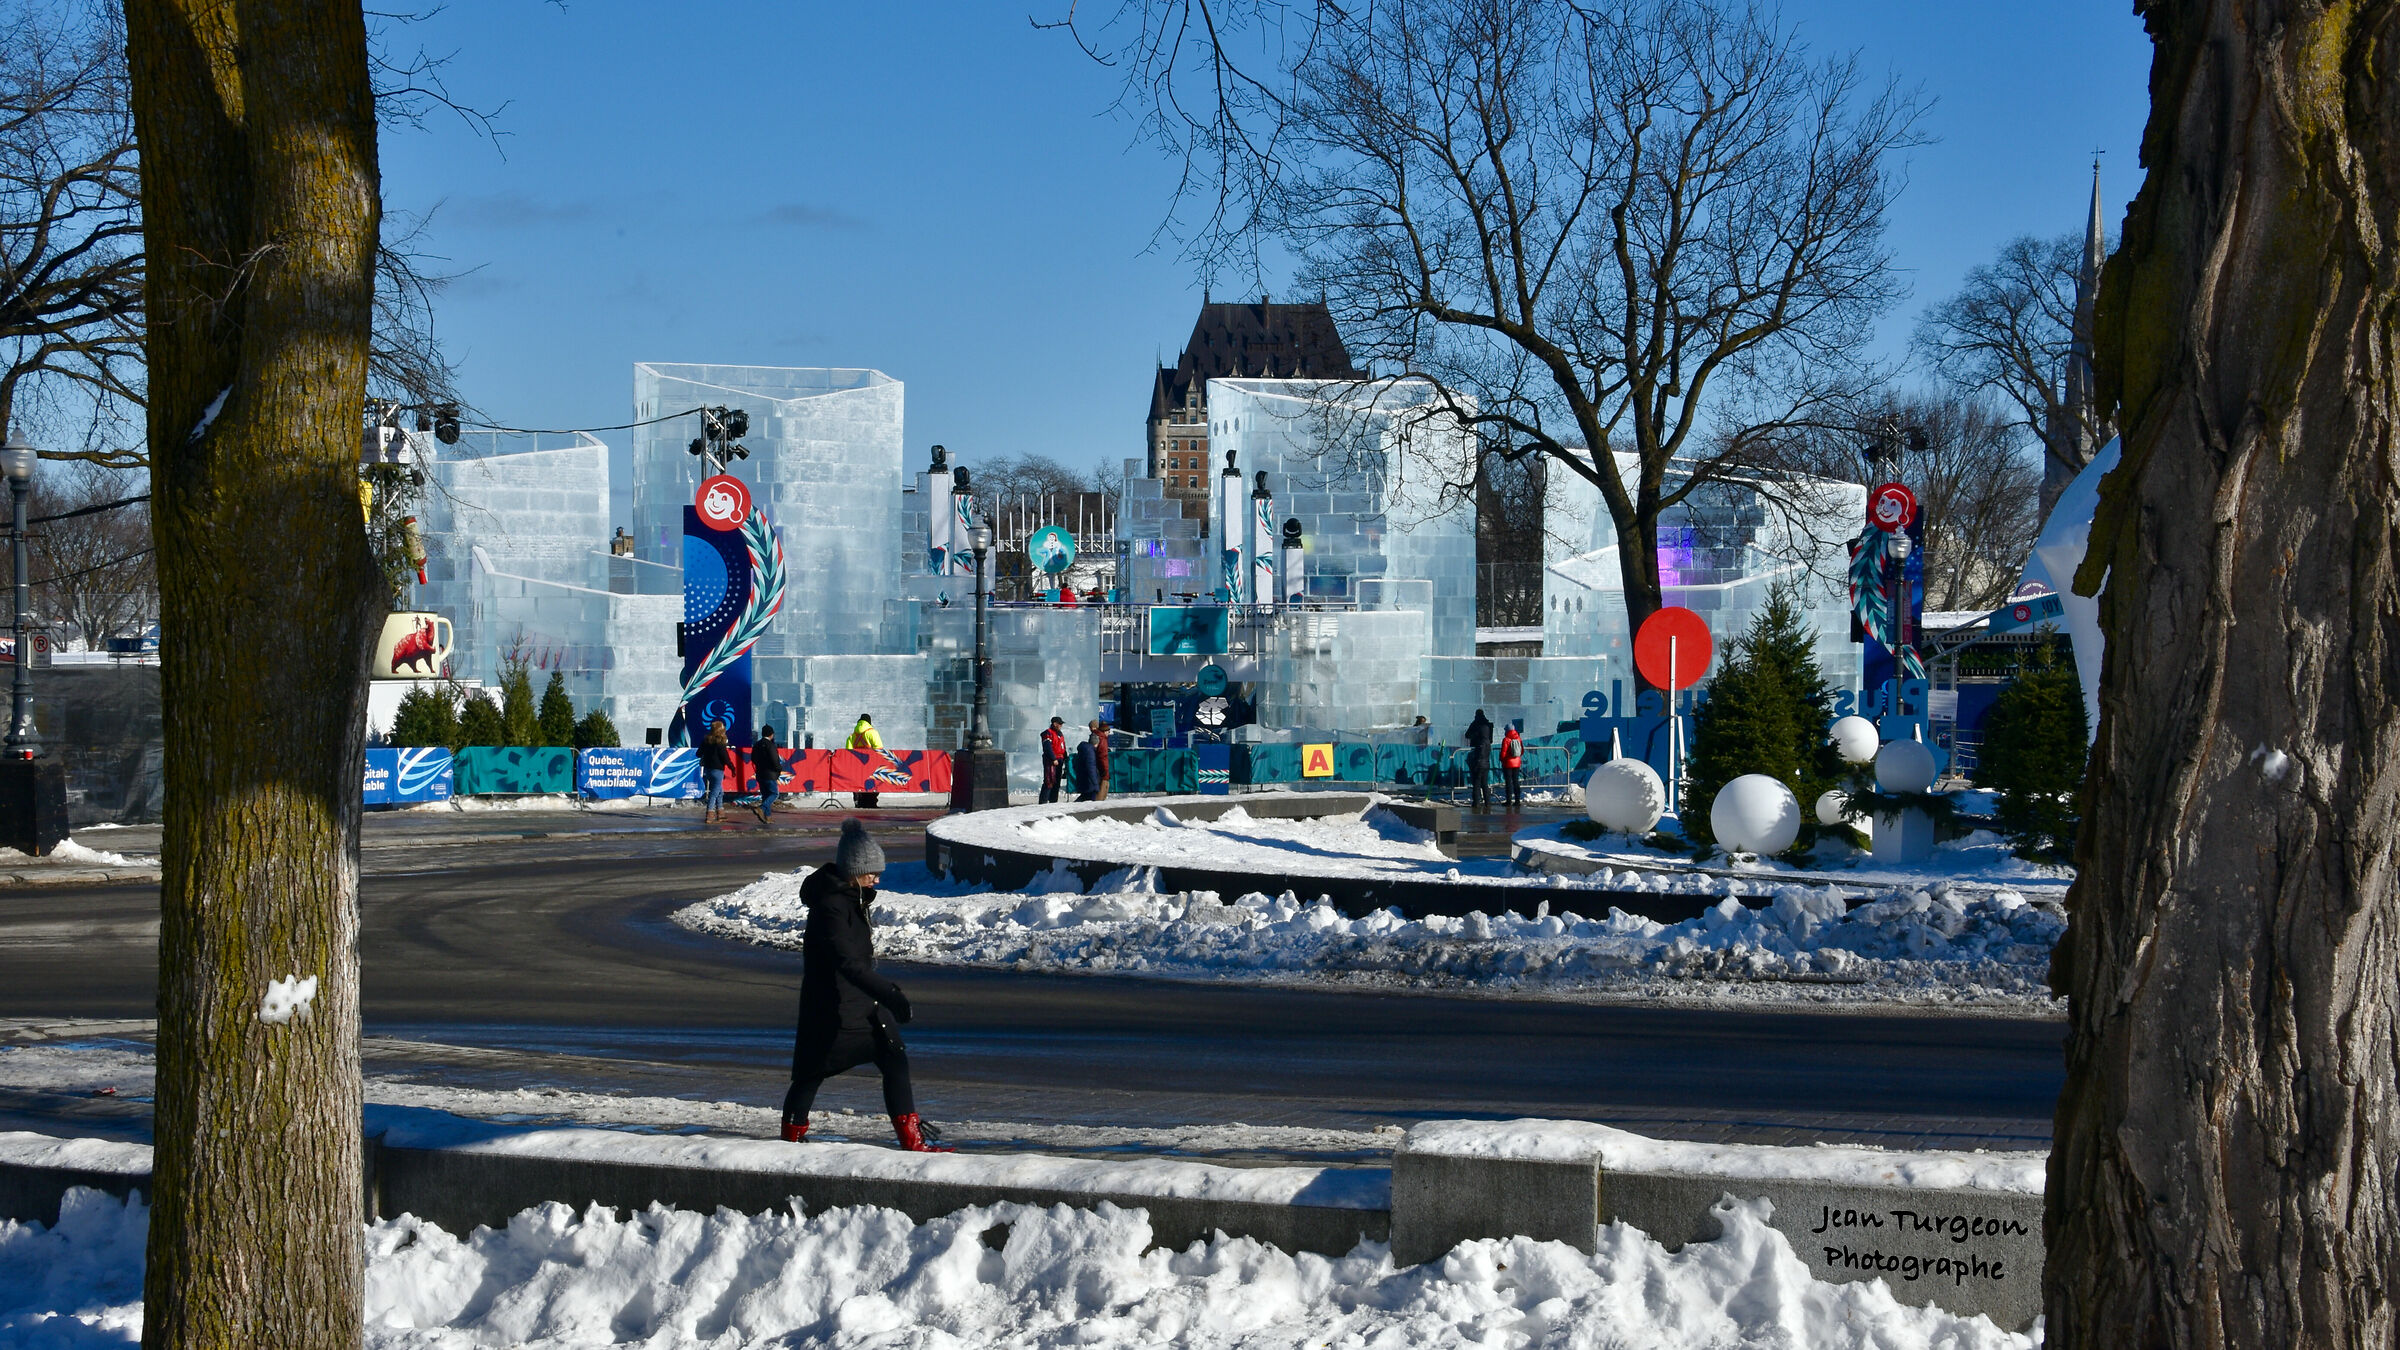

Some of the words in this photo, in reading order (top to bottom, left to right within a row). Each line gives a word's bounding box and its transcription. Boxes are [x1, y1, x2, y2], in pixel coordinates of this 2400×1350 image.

[384, 433, 406, 443] BAR
[1172, 630, 1198, 641] Zone
[589, 755, 625, 767] Québec,
[1308, 749, 1329, 771] A
[589, 768, 604, 777] une
[606, 767, 643, 778] capitale
